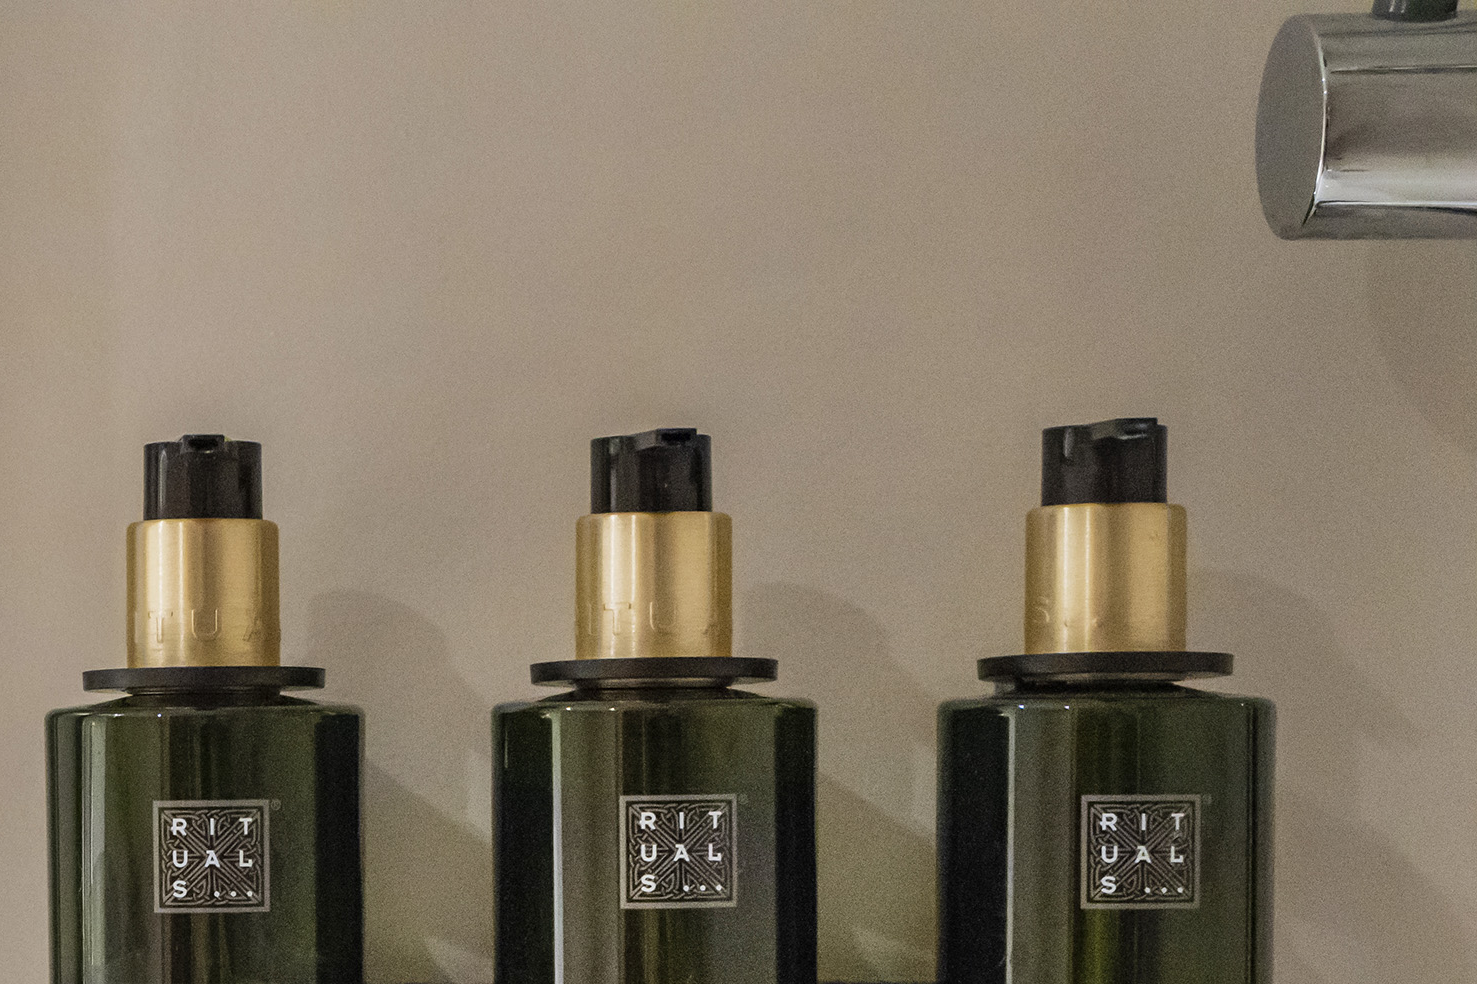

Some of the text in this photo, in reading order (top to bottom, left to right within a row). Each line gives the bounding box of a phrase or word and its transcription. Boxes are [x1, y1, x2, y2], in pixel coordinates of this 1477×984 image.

[171, 818, 253, 836] RIT
[640, 812, 722, 830] RIT
[1100, 813, 1185, 831] RIT
[172, 850, 253, 868] UAL
[641, 844, 722, 862] UAL
[1101, 846, 1184, 863] UAL
